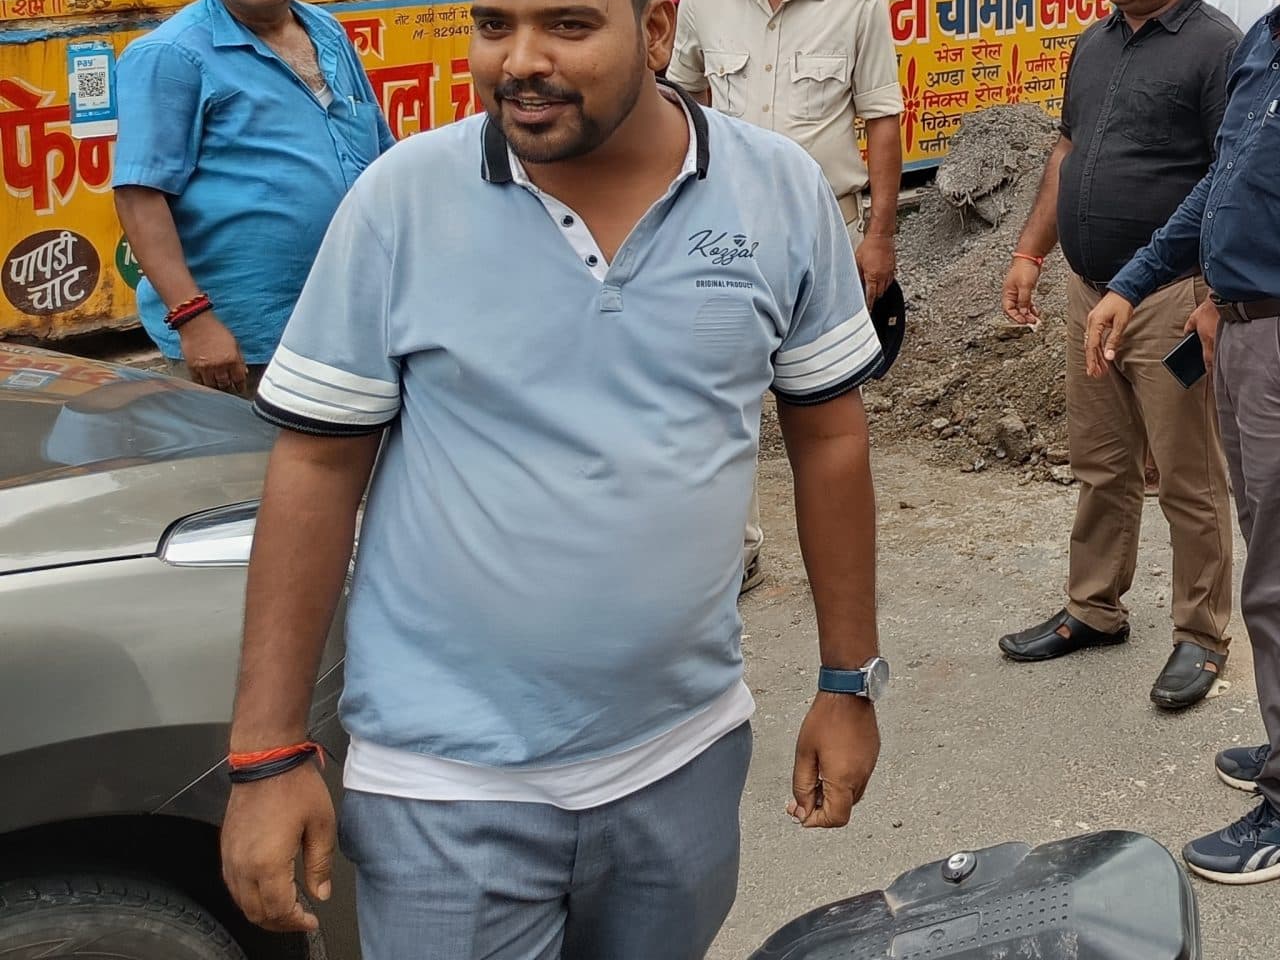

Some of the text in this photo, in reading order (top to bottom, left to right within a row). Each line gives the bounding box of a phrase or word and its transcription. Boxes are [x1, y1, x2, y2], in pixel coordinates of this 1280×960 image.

[972, 40, 1003, 60] रोल
[1025, 54, 1057, 74] पनीर
[925, 64, 1002, 88] अण्डा रोल
[1024, 76, 1056, 94] सोया
[975, 84, 1004, 103] रोल
[919, 134, 951, 154] पनी
[27, 266, 88, 309] चाट
[696, 280, 725, 289] ORIGINAL
